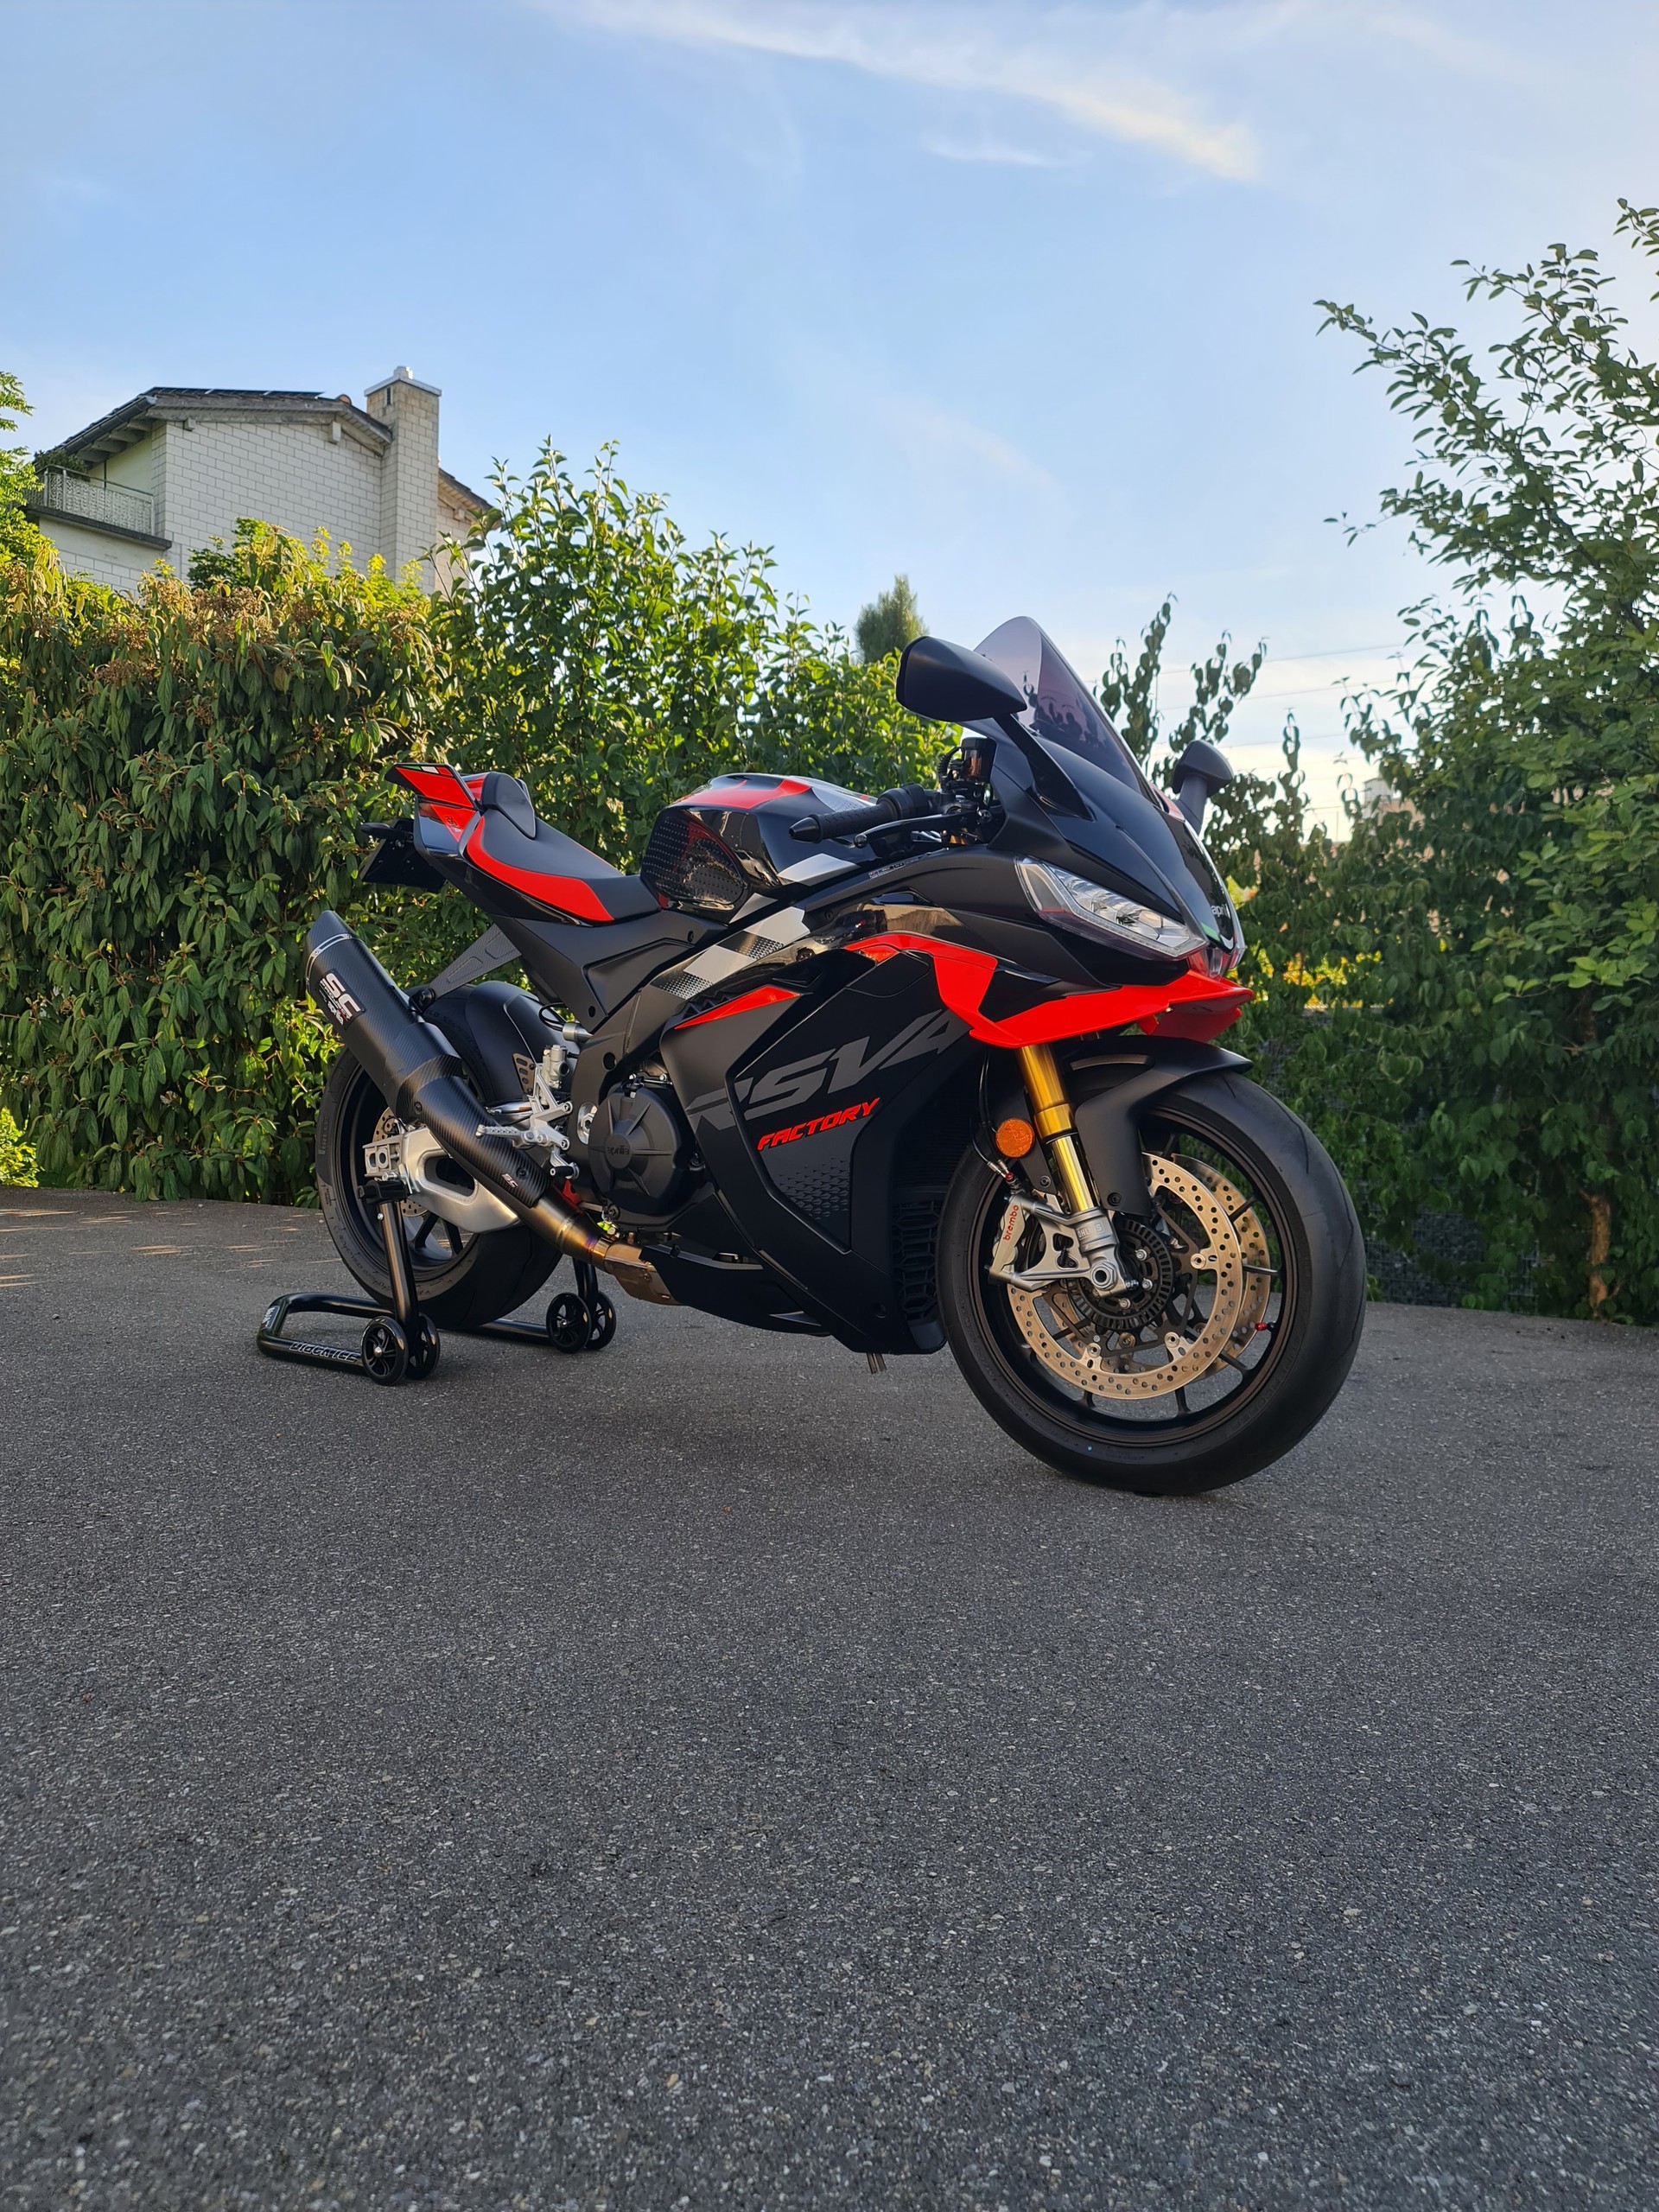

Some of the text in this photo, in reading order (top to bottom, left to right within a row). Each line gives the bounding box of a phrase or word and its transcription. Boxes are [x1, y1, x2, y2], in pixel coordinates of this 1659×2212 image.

[322, 973, 361, 1017] SC
[757, 1097, 880, 1151] FACTORY
[1003, 1205, 1019, 1241] brembo
